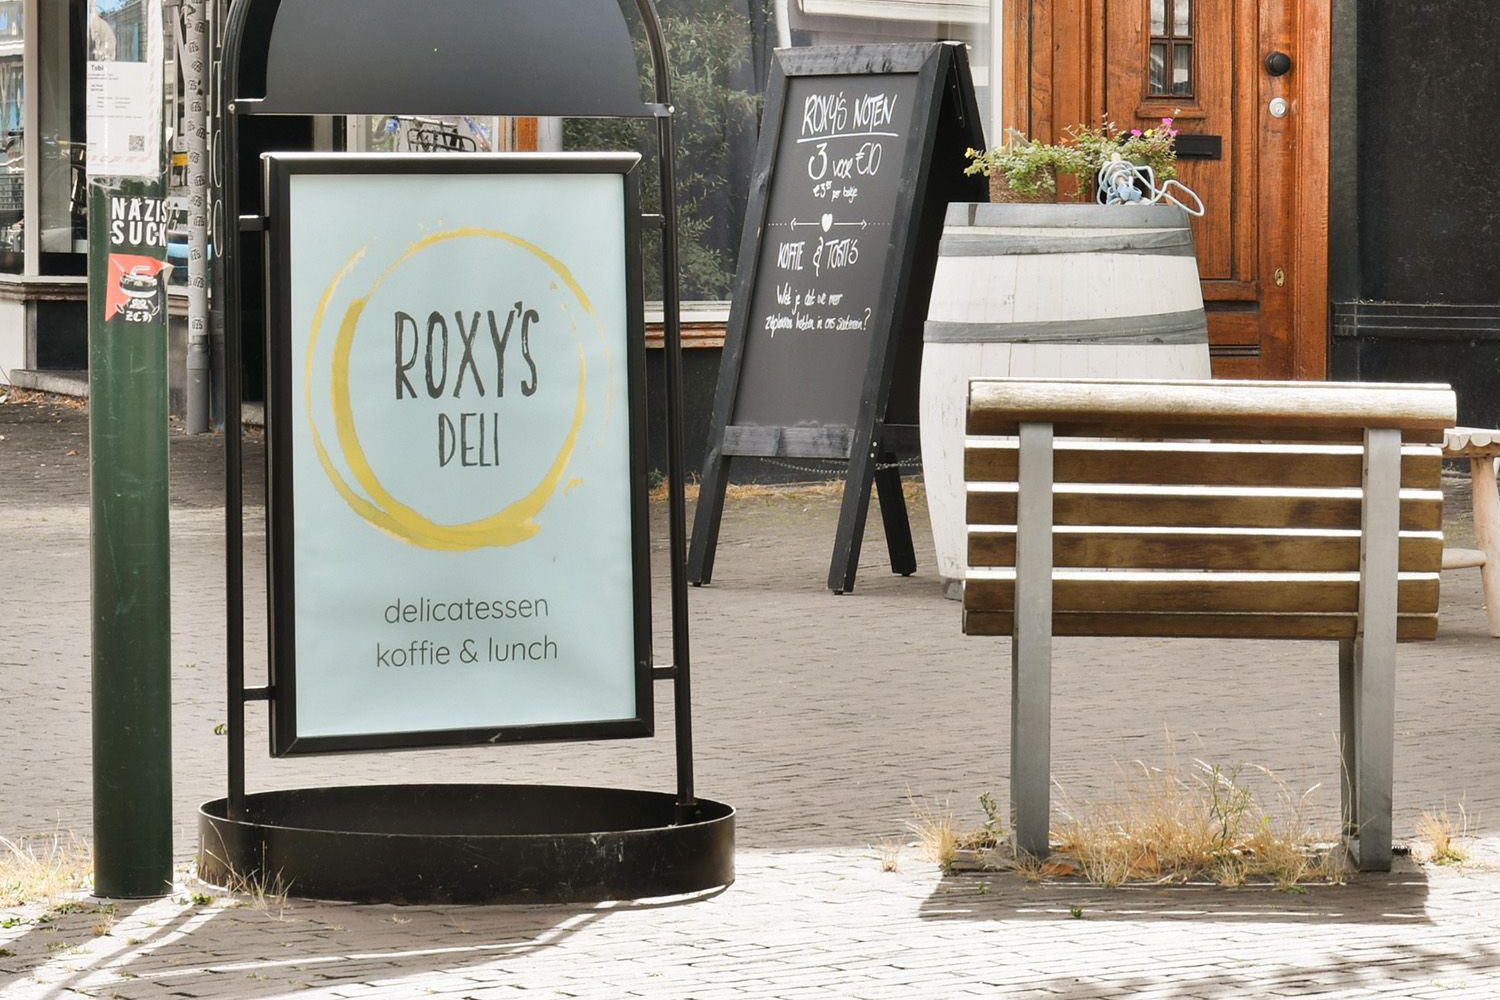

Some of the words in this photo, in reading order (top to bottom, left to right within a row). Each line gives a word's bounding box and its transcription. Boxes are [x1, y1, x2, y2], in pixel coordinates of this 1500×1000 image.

[802, 91, 848, 136] ROXY'S
[853, 93, 897, 132] NOTEN
[808, 142, 828, 181] 3
[111, 197, 168, 223] NAZIS
[111, 220, 167, 247] SUCK
[812, 236, 823, 277] &
[395, 301, 540, 400] ROXY'S
[438, 412, 500, 468] DELI
[384, 597, 549, 624] delicatessen
[376, 640, 450, 668] koffie
[459, 638, 479, 664] &
[488, 634, 558, 662] lunch
